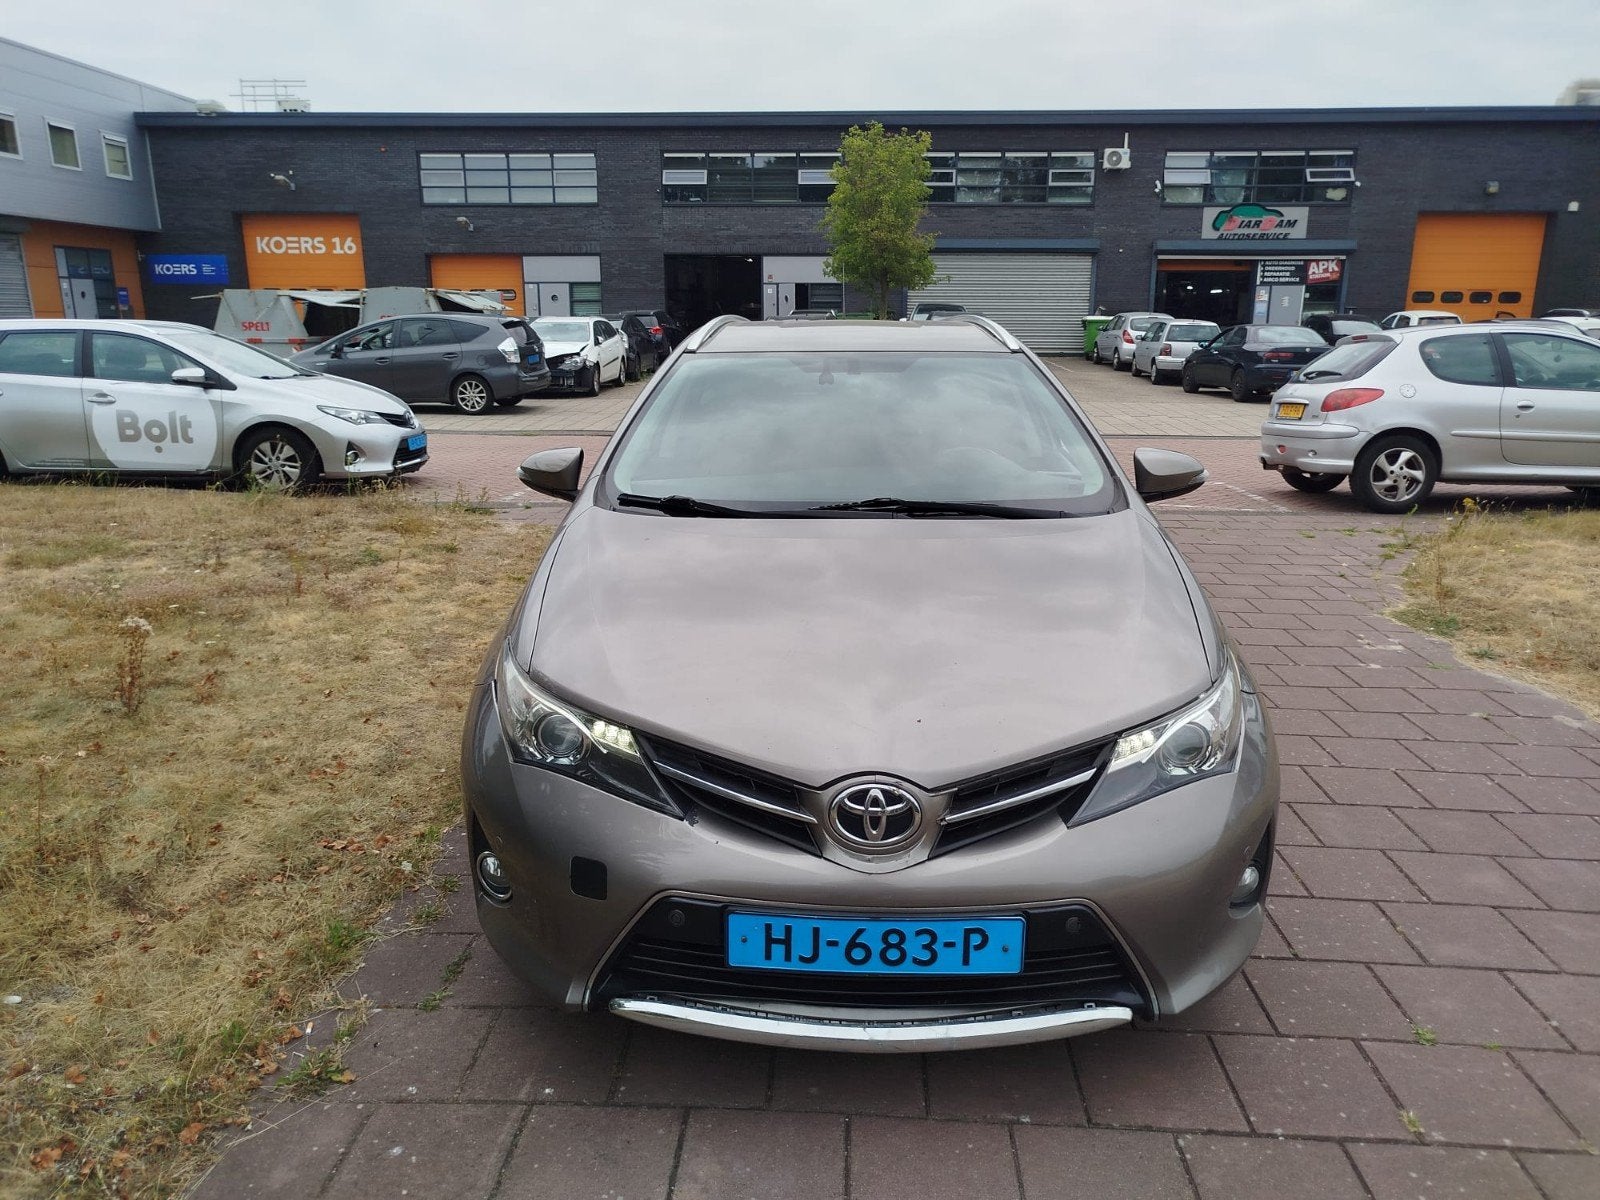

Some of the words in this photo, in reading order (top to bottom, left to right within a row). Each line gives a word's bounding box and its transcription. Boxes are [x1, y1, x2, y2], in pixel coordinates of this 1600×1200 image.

[1217, 232, 1291, 240] AUTOSERVICE
[256, 236, 326, 254] KOERS
[331, 237, 357, 254] 16
[154, 264, 197, 275] KOERS
[1308, 259, 1339, 275] APK
[764, 923, 989, 966] HJ-683-P
